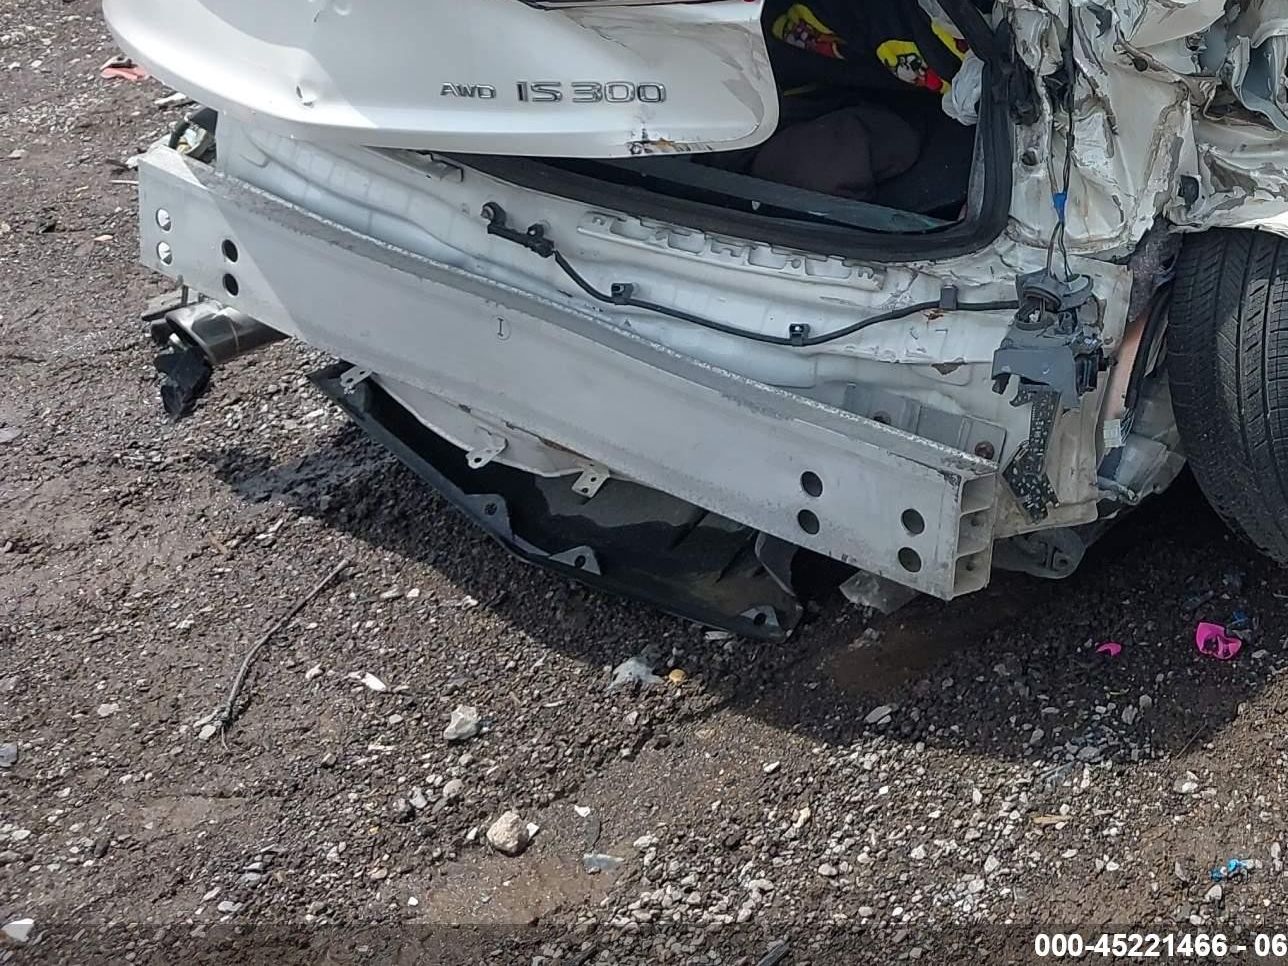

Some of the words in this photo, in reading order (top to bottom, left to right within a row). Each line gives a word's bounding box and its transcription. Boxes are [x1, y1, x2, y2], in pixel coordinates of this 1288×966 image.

[439, 82, 497, 100] AWD
[516, 81, 564, 103] IS
[571, 81, 667, 103] 300
